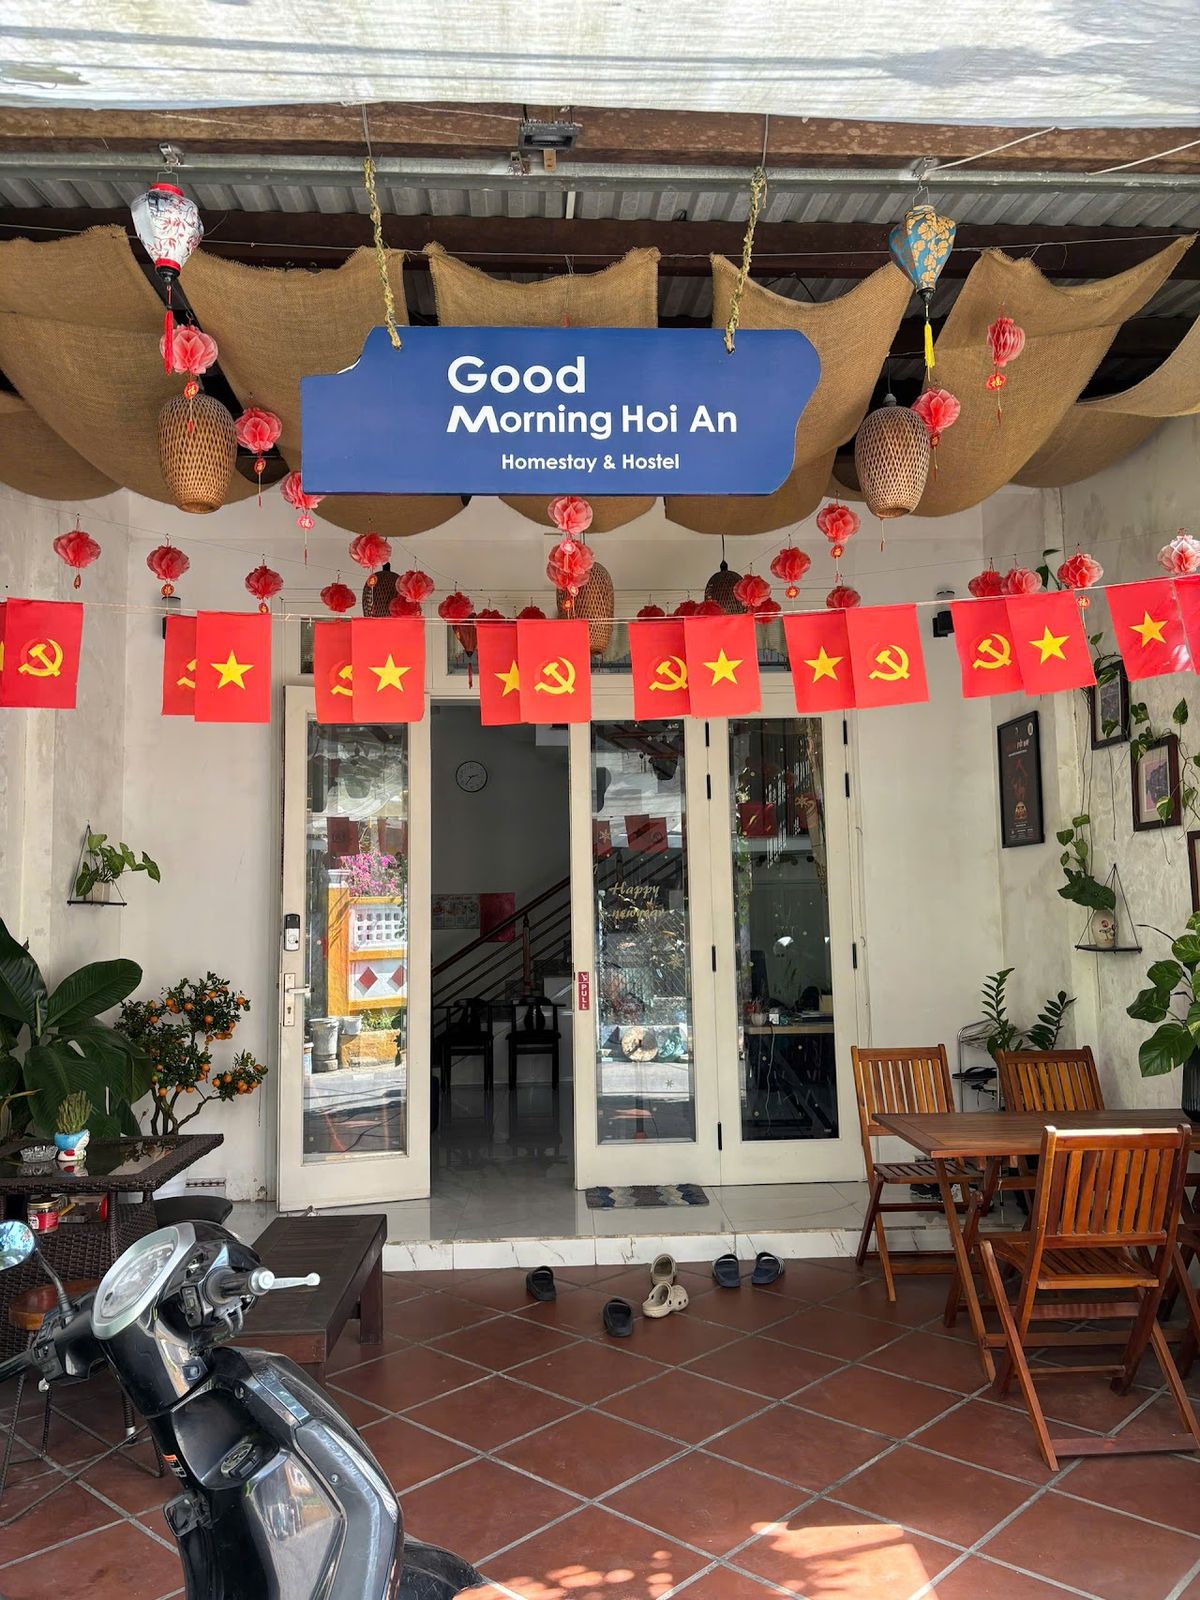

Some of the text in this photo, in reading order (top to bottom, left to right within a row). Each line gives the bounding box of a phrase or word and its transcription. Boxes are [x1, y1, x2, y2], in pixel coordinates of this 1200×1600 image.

[447, 355, 586, 394] Good
[446, 403, 737, 440] Morning Hoi An
[501, 453, 680, 473] Homestay & Hostel
[608, 881, 660, 899] Happy
